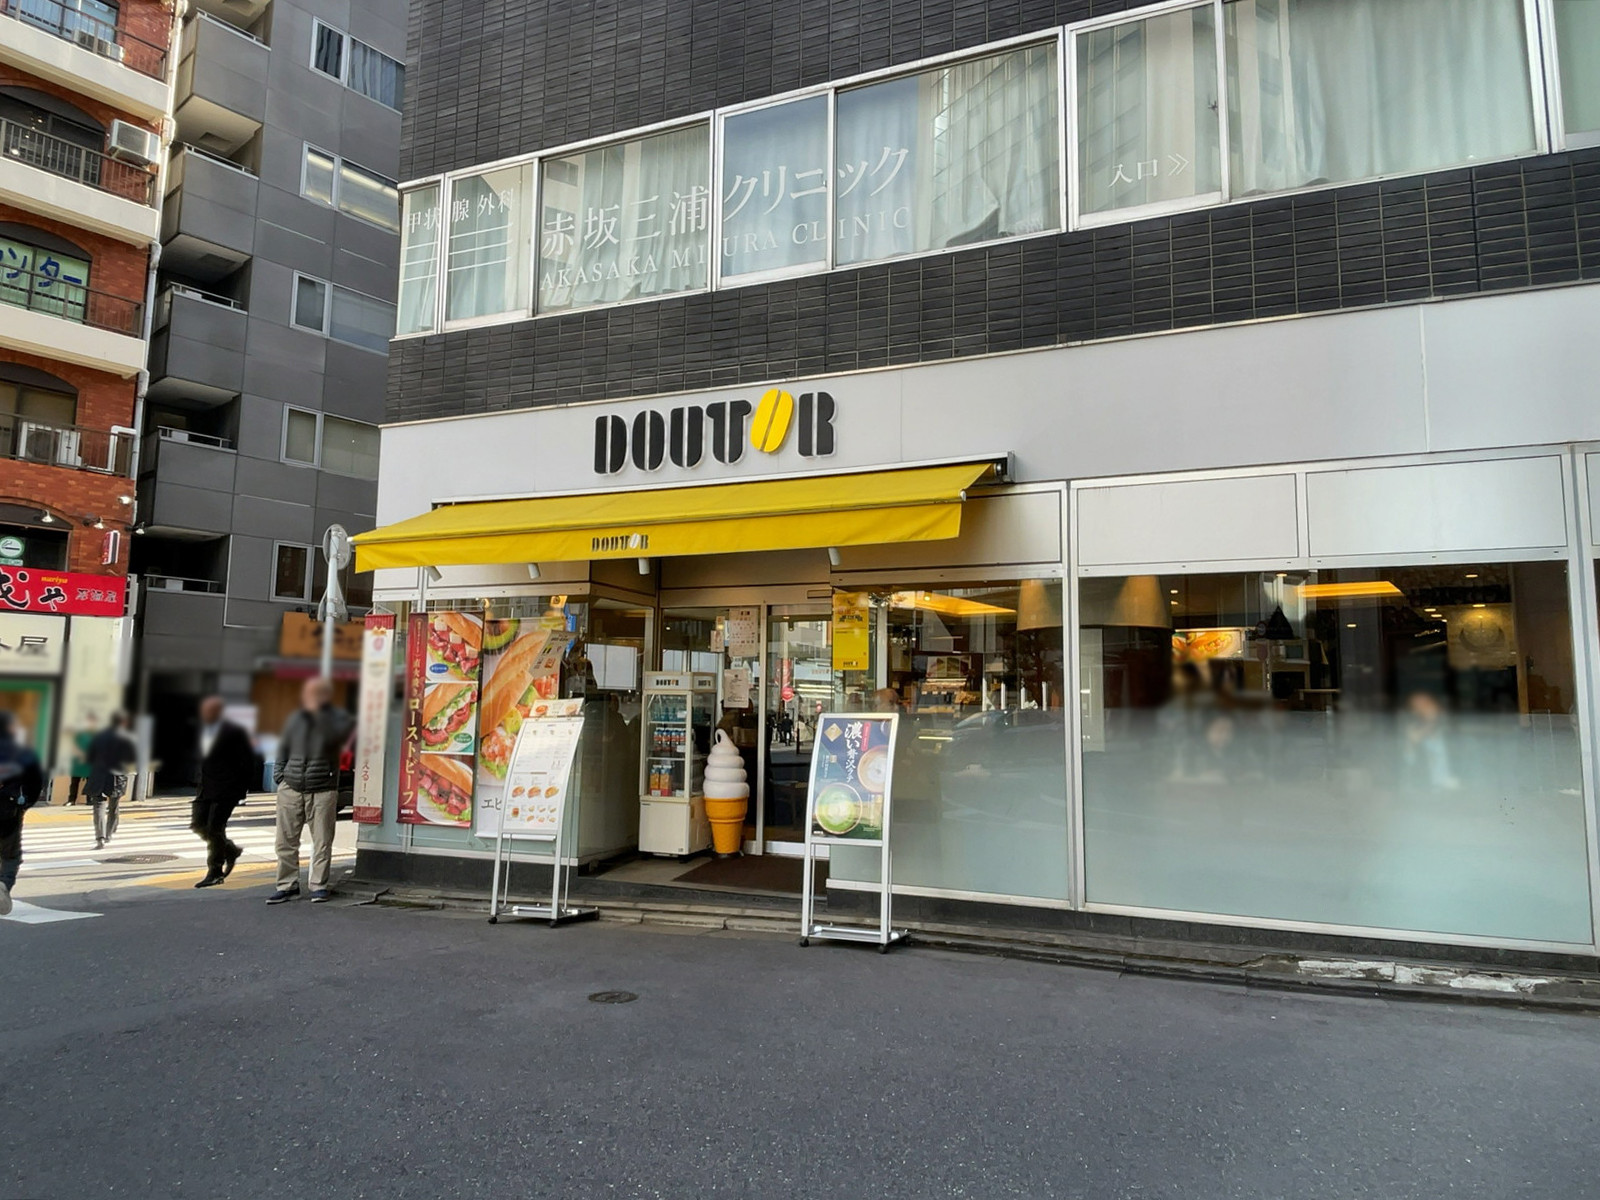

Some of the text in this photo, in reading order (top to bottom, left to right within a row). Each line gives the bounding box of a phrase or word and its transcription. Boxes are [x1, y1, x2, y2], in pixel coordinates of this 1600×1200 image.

[1108, 159, 1158, 188] 入口
[407, 188, 514, 234] 甲状腺外科
[542, 146, 909, 258] 赤坂三浦クリニック
[0, 248, 82, 287] ンター
[540, 207, 910, 291] AKASAKA MIURA CLINIC
[594, 388, 836, 475] DOUTOR
[592, 533, 649, 552] DOUTOR
